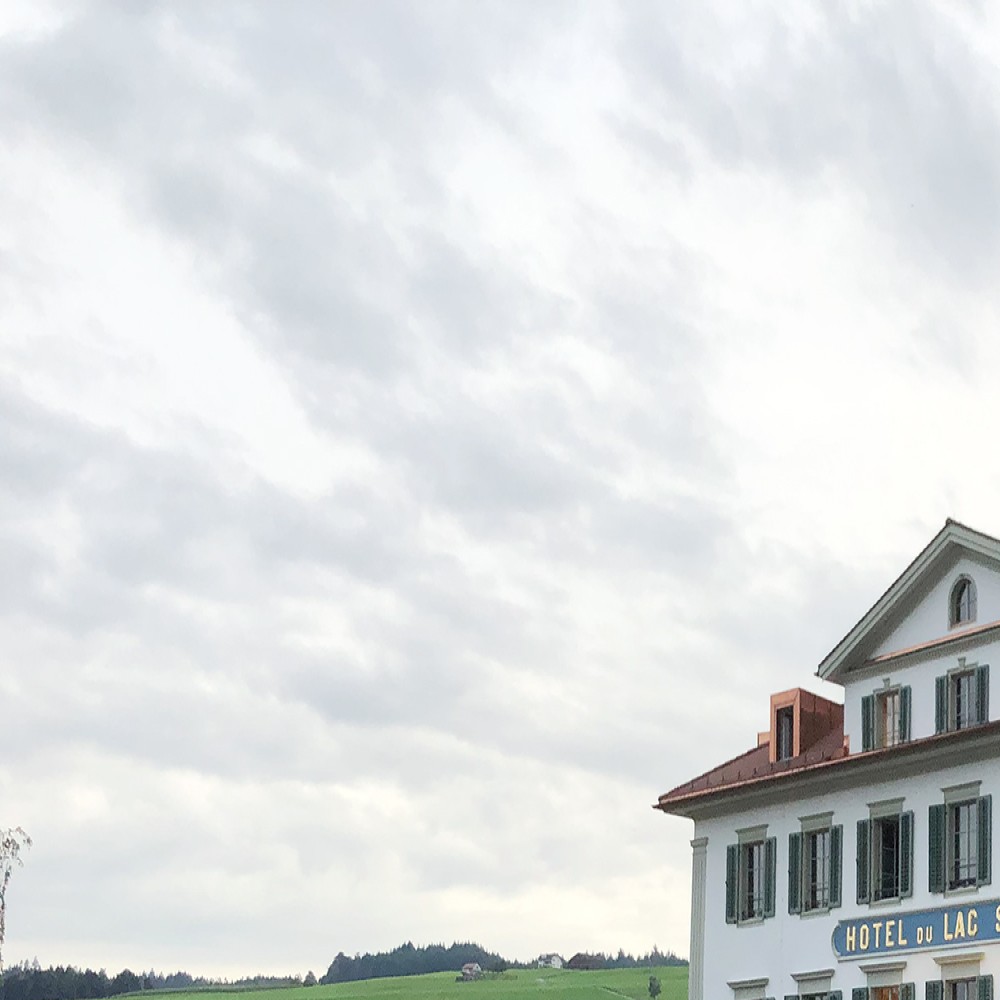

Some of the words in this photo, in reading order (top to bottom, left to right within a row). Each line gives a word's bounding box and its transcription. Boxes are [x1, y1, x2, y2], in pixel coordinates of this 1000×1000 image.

[846, 920, 907, 952] HOTEL
[916, 925, 933, 945] DU
[943, 908, 979, 941] LAC
